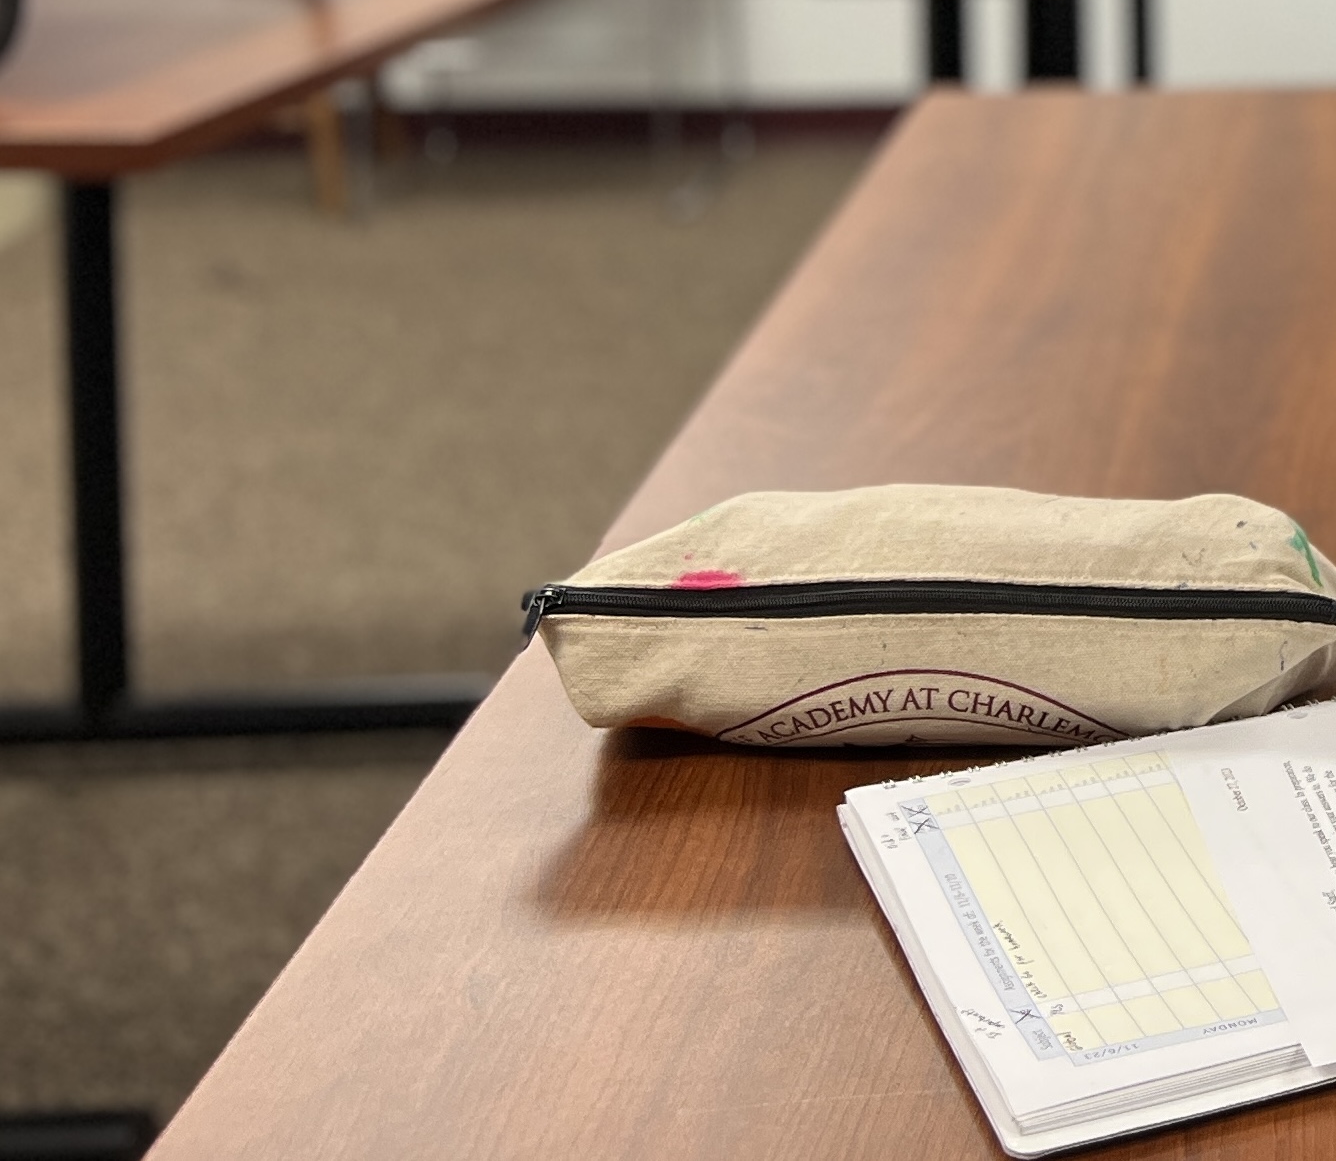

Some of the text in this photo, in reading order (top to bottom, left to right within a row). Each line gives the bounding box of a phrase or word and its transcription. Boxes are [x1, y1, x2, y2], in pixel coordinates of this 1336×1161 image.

[757, 689, 894, 743] ACADEMY
[901, 688, 939, 711] AT
[989, 956, 1015, 991] Assignments
[1202, 1017, 1258, 1035] MONDAY
